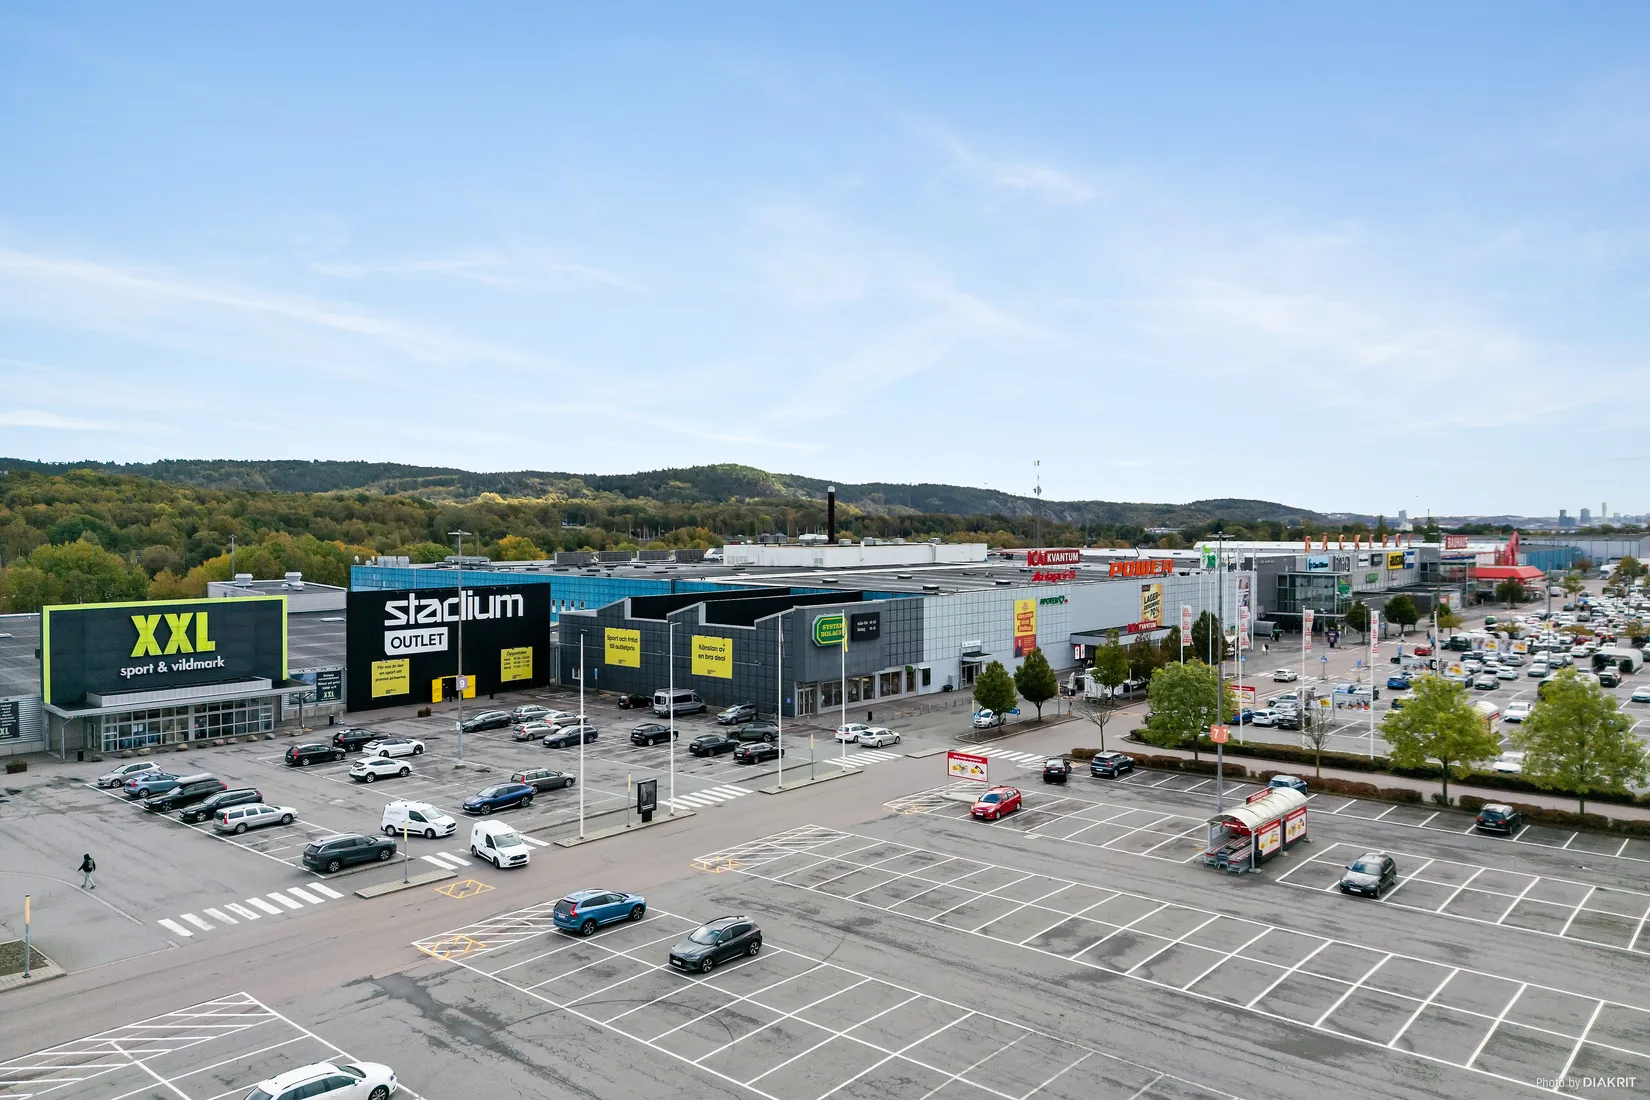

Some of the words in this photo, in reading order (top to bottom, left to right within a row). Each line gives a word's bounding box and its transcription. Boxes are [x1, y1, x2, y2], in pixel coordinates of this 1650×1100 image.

[1047, 552, 1078, 562] KVANTUM
[1109, 559, 1173, 578] POWER
[384, 590, 524, 626] stadium
[131, 611, 216, 657] XXL
[390, 633, 445, 649] OUTLET
[120, 662, 154, 678] sport
[157, 661, 168, 673] &
[171, 655, 225, 672] vildmark
[1432, 661, 1437, 669] 6
[459, 679, 465, 688] 9
[1213, 728, 1219, 740] 7
